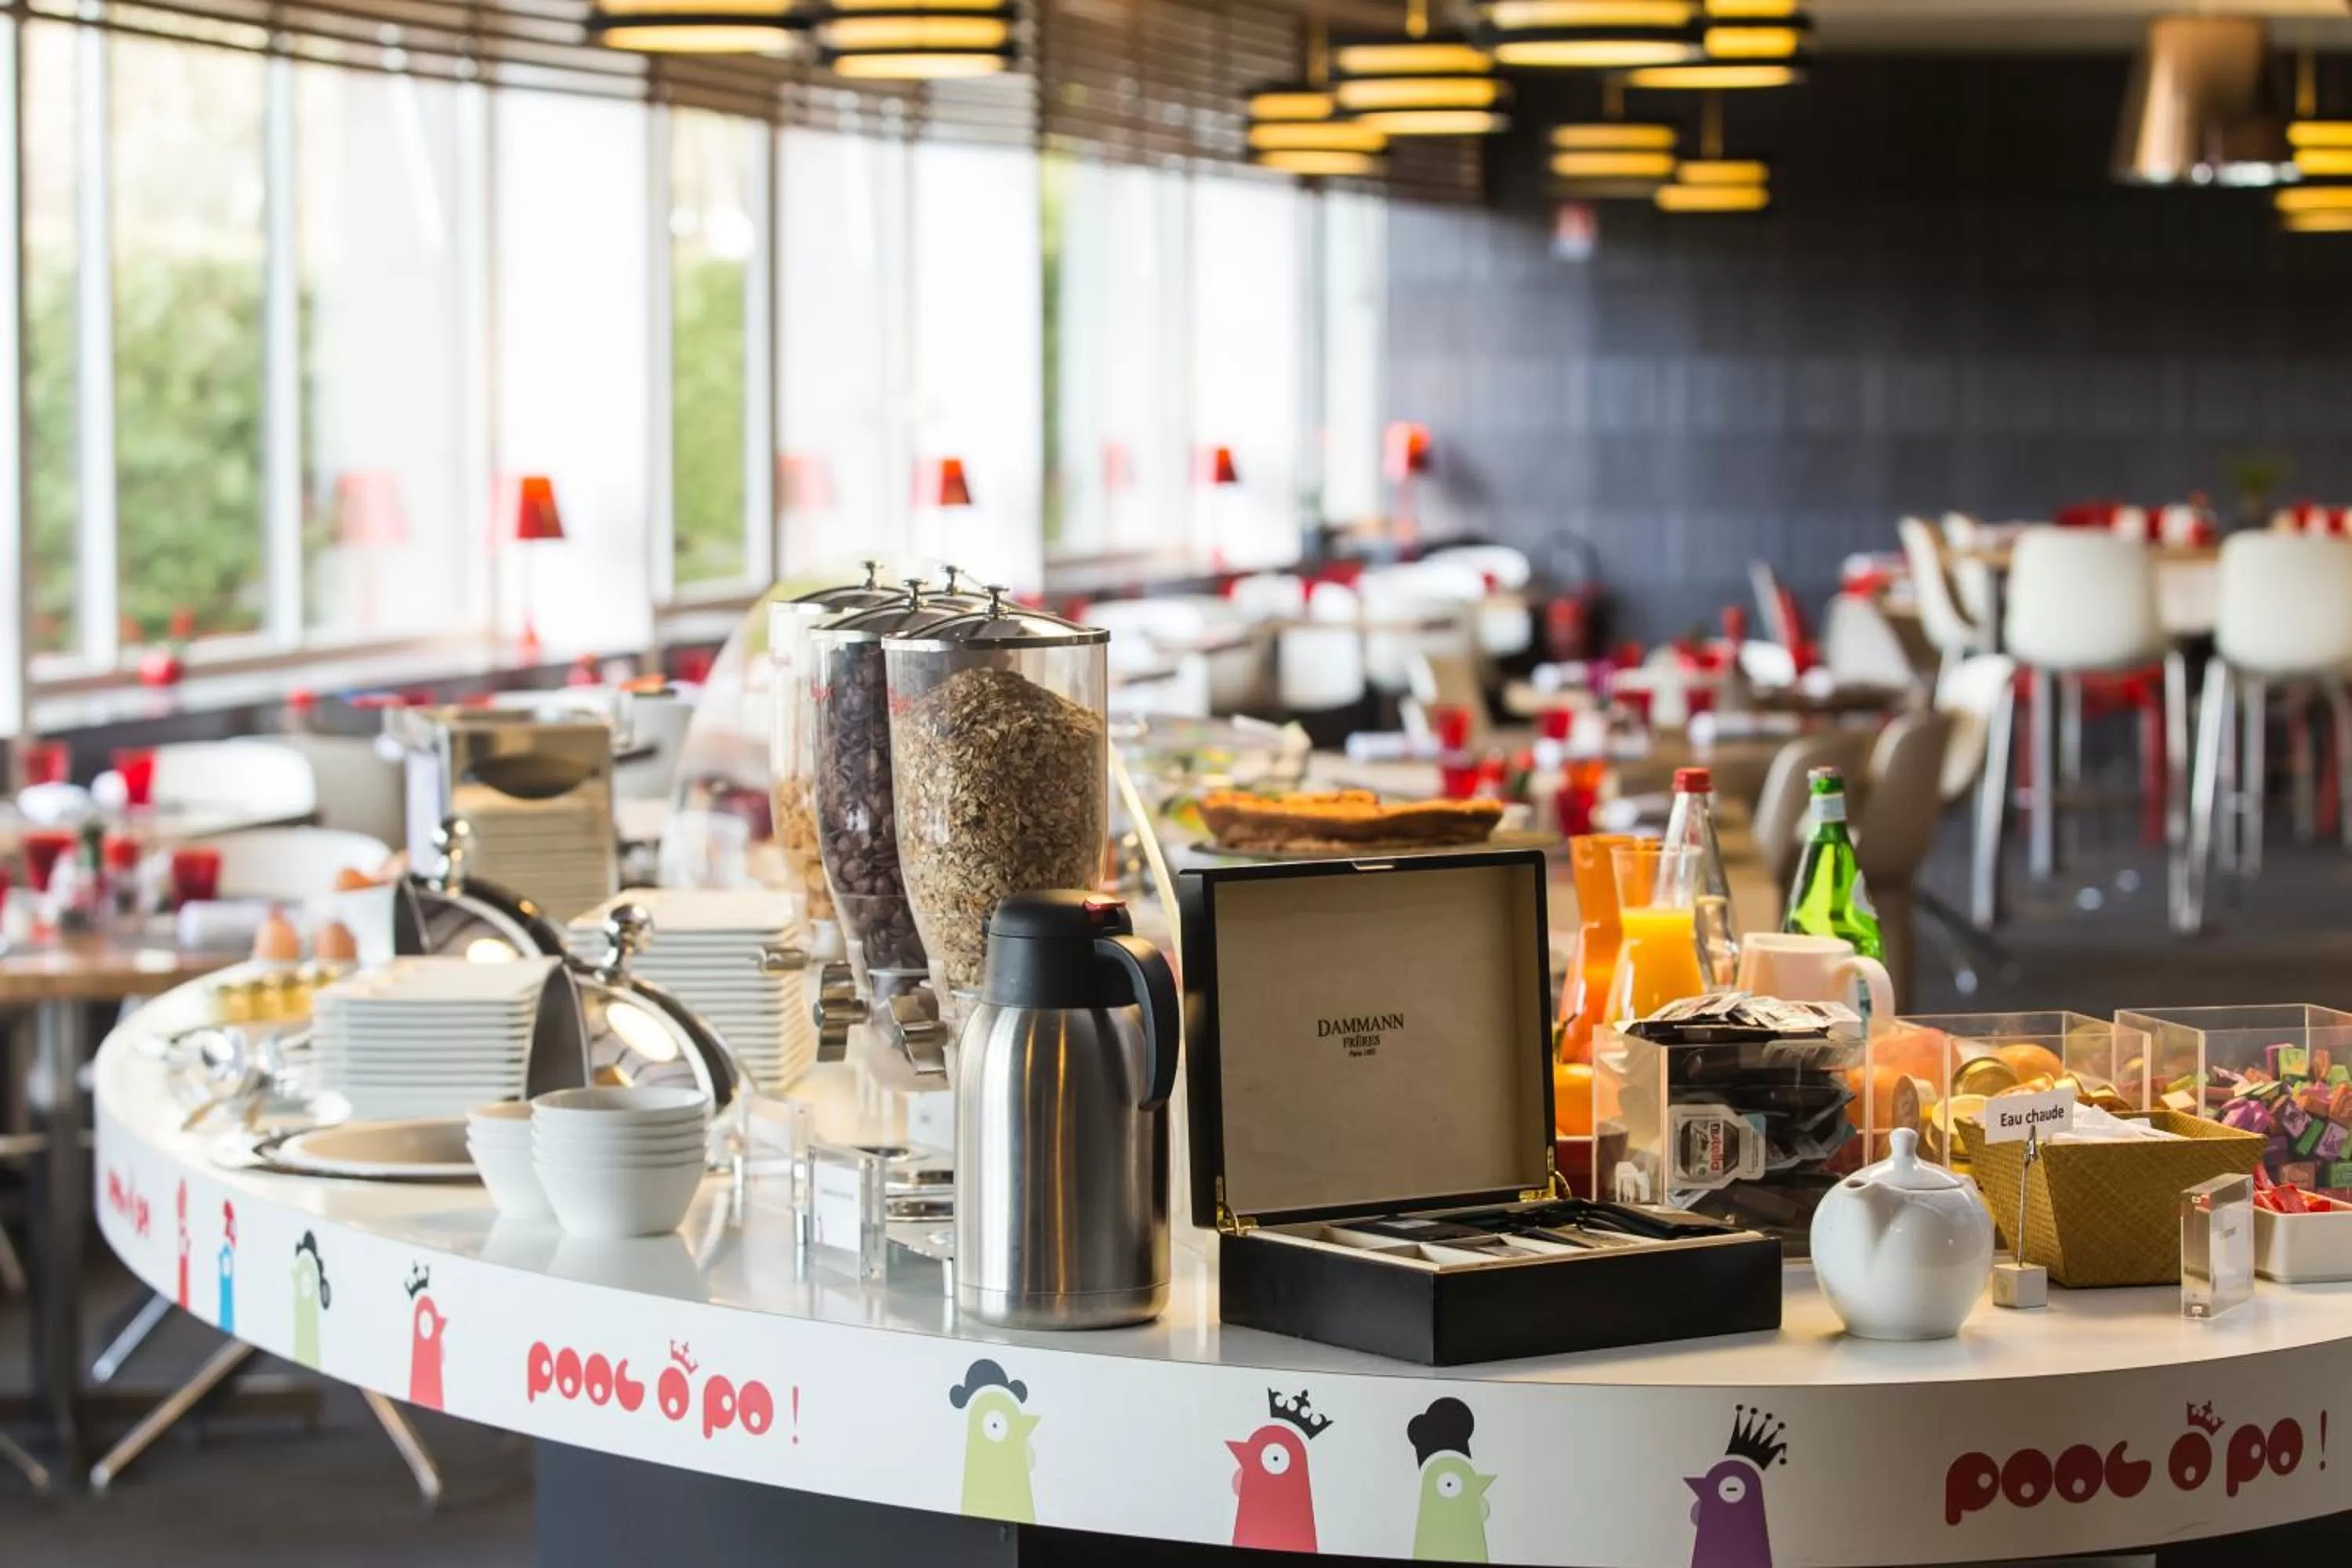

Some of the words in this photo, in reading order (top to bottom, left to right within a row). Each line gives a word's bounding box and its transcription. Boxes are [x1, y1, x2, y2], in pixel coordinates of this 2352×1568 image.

[1317, 1013, 1404, 1037] DAMMANN
[2000, 1112, 2023, 1127] Eau
[2025, 1105, 2065, 1123] chaude
